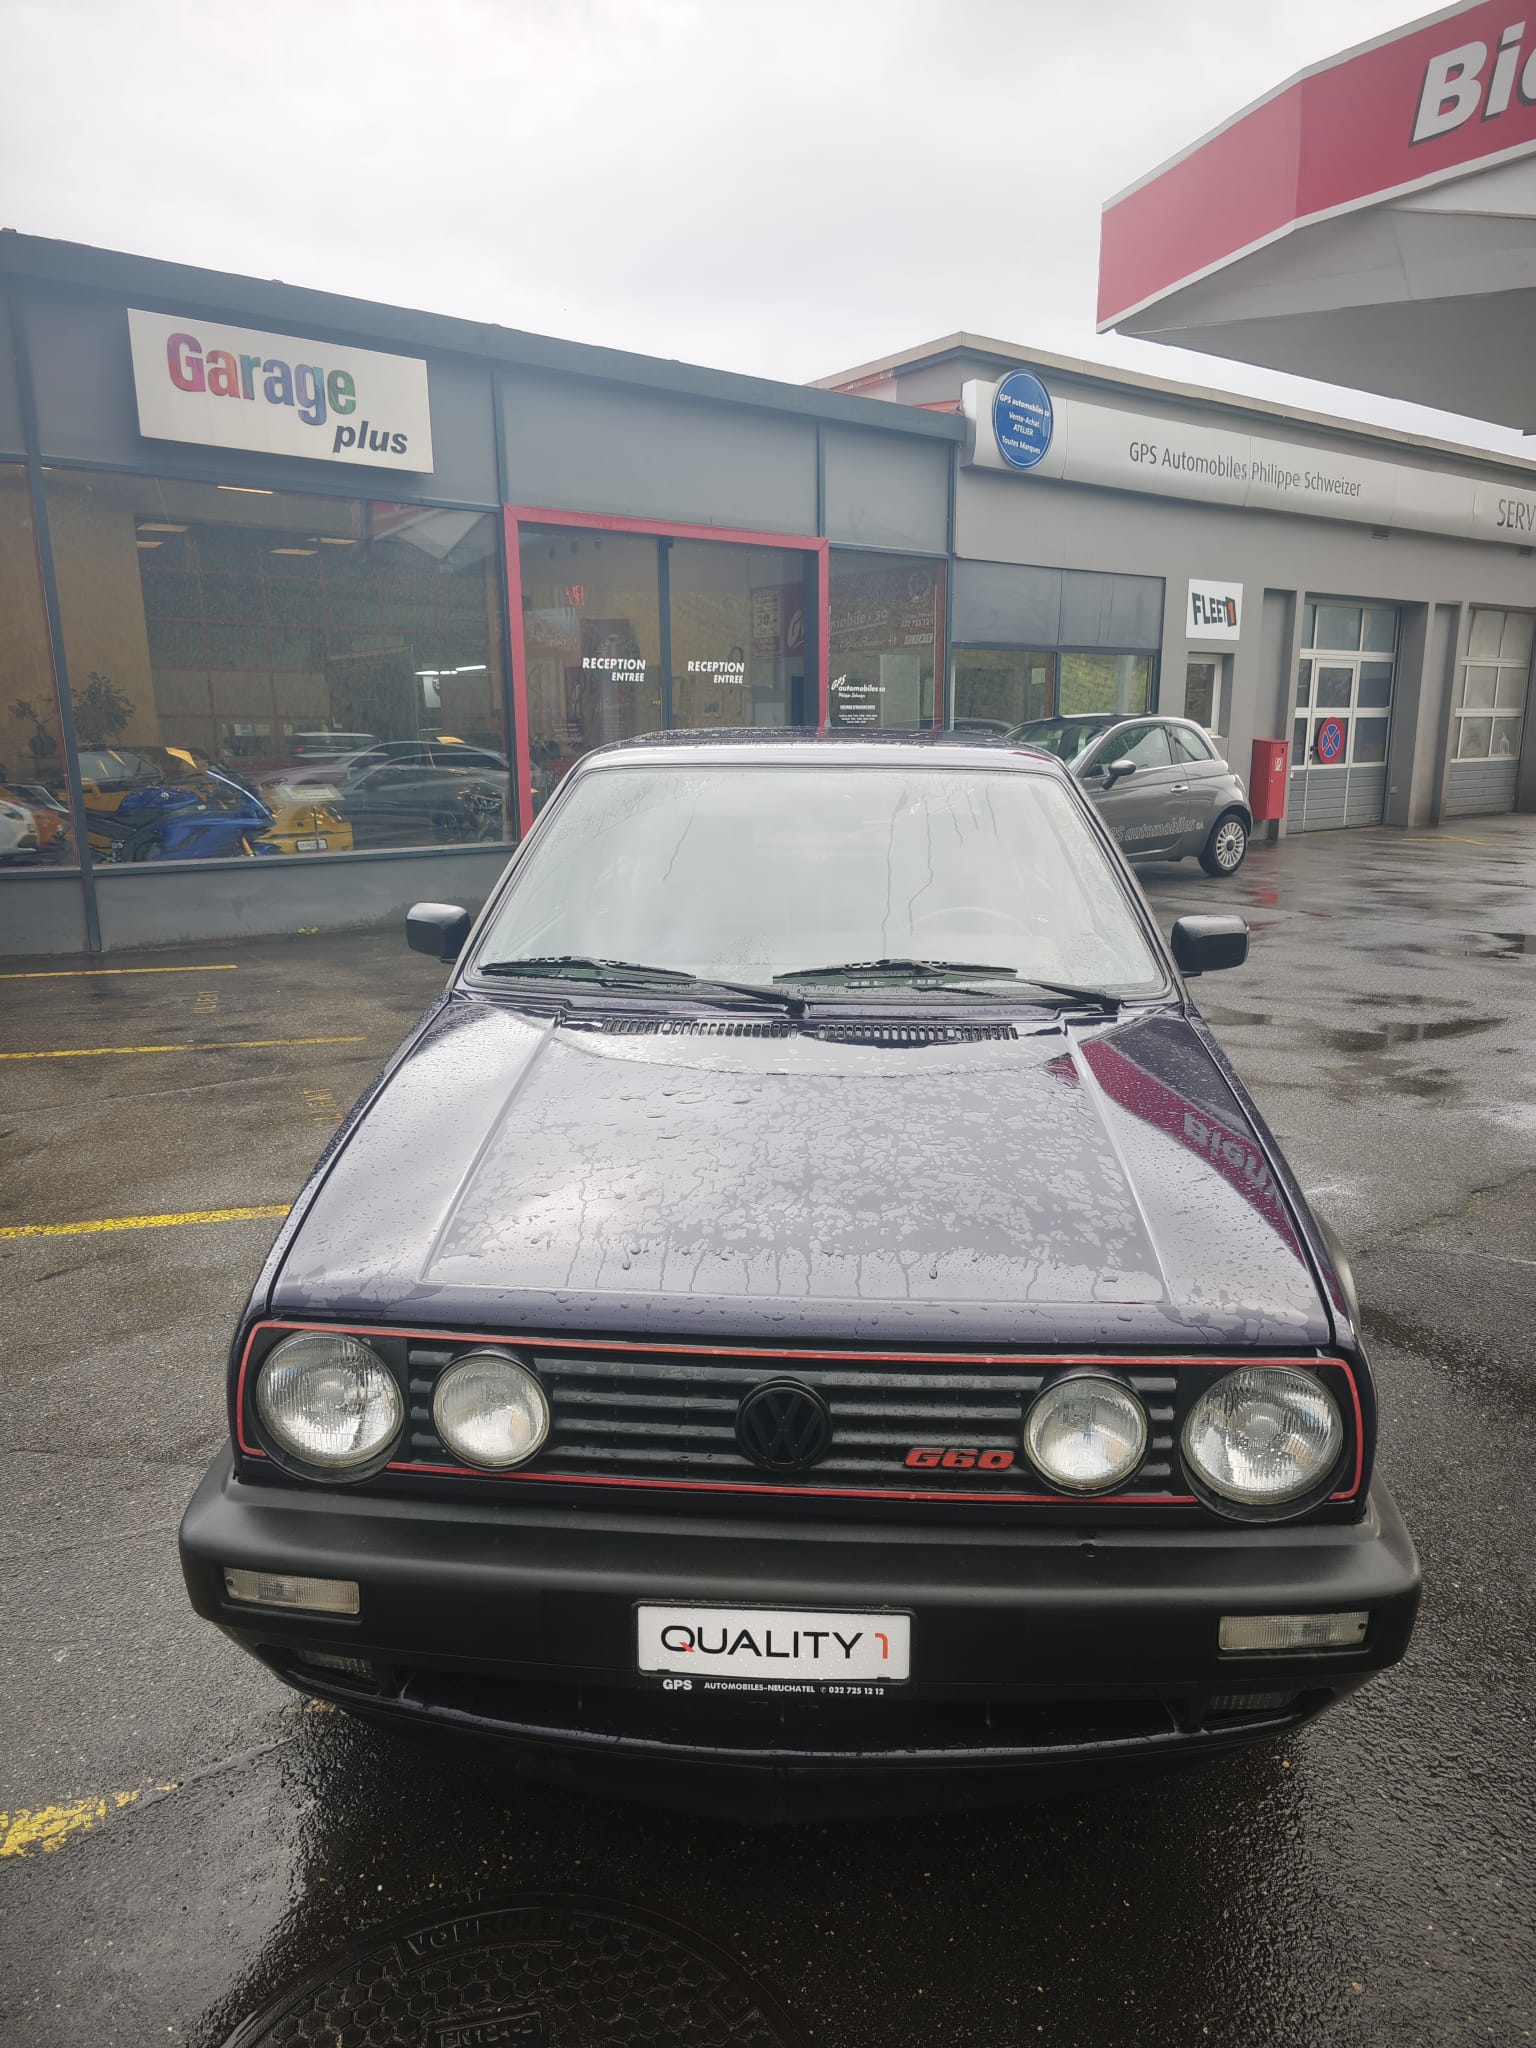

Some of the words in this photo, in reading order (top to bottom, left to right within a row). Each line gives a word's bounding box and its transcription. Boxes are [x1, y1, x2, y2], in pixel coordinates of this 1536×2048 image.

[166, 332, 356, 426] Garage
[1000, 394, 1012, 404] GPS
[1012, 399, 1044, 415] automobiles
[1009, 411, 1040, 428] Vente-Achat
[333, 420, 408, 454] plus
[1013, 424, 1034, 437] ATELIER
[1002, 435, 1019, 448] Toutes
[1020, 441, 1041, 455] Marques
[1129, 442, 1157, 464] GPS
[1162, 448, 1248, 480] Automobiles
[1251, 461, 1301, 491] Philippe
[1304, 471, 1362, 497] Schweizer
[582, 657, 646, 671] RECEPTION
[687, 660, 745, 673] RECEPTION
[611, 672, 646, 682] ENTREE
[713, 674, 744, 684] ENTREE
[831, 674, 847, 691] GPS
[838, 684, 879, 692] automobiles
[1125, 816, 1196, 841] automobiles
[905, 1448, 1015, 1469] G60
[663, 1679, 693, 1691] GPS
[704, 1681, 815, 1694] AUTOMOBILES-NEUCHATEL
[829, 1686, 844, 1694] 032
[846, 1687, 861, 1695] 725
[864, 1687, 873, 1695] 12
[875, 1688, 884, 1696] 12
